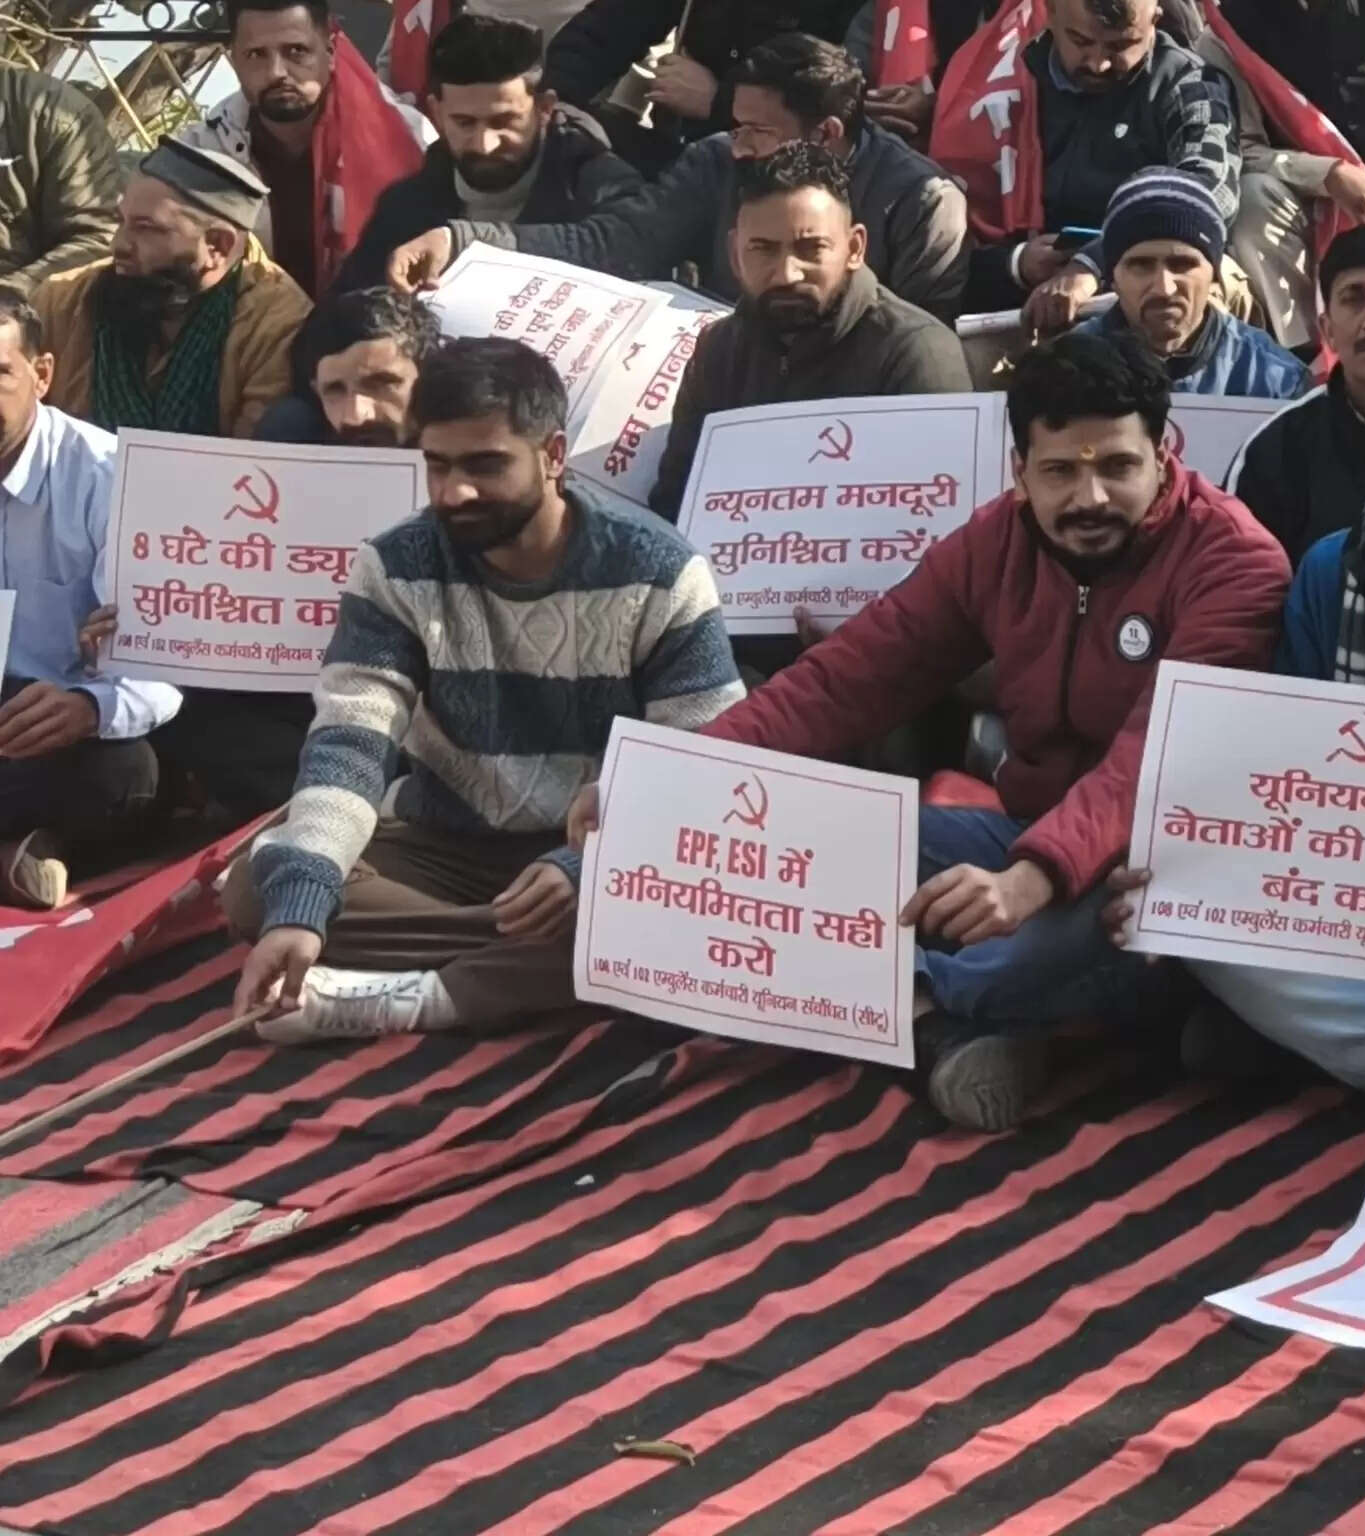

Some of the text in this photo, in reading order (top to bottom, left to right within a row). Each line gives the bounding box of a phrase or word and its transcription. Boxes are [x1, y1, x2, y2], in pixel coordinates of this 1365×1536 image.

[603, 325, 698, 477] श्रम काननों
[704, 473, 960, 523] न्यूनतम मजदूरी
[132, 525, 358, 584] 8 घंटे की ड्यू
[710, 527, 938, 576] सुनिश्चित करें
[132, 578, 285, 626] सुनिश्चित
[1164, 805, 1303, 853] नेताओं
[676, 826, 814, 889] EPF, ESI में
[605, 864, 886, 949] अनियमितता सही
[1262, 867, 1325, 906] बंद
[707, 936, 777, 977] करो
